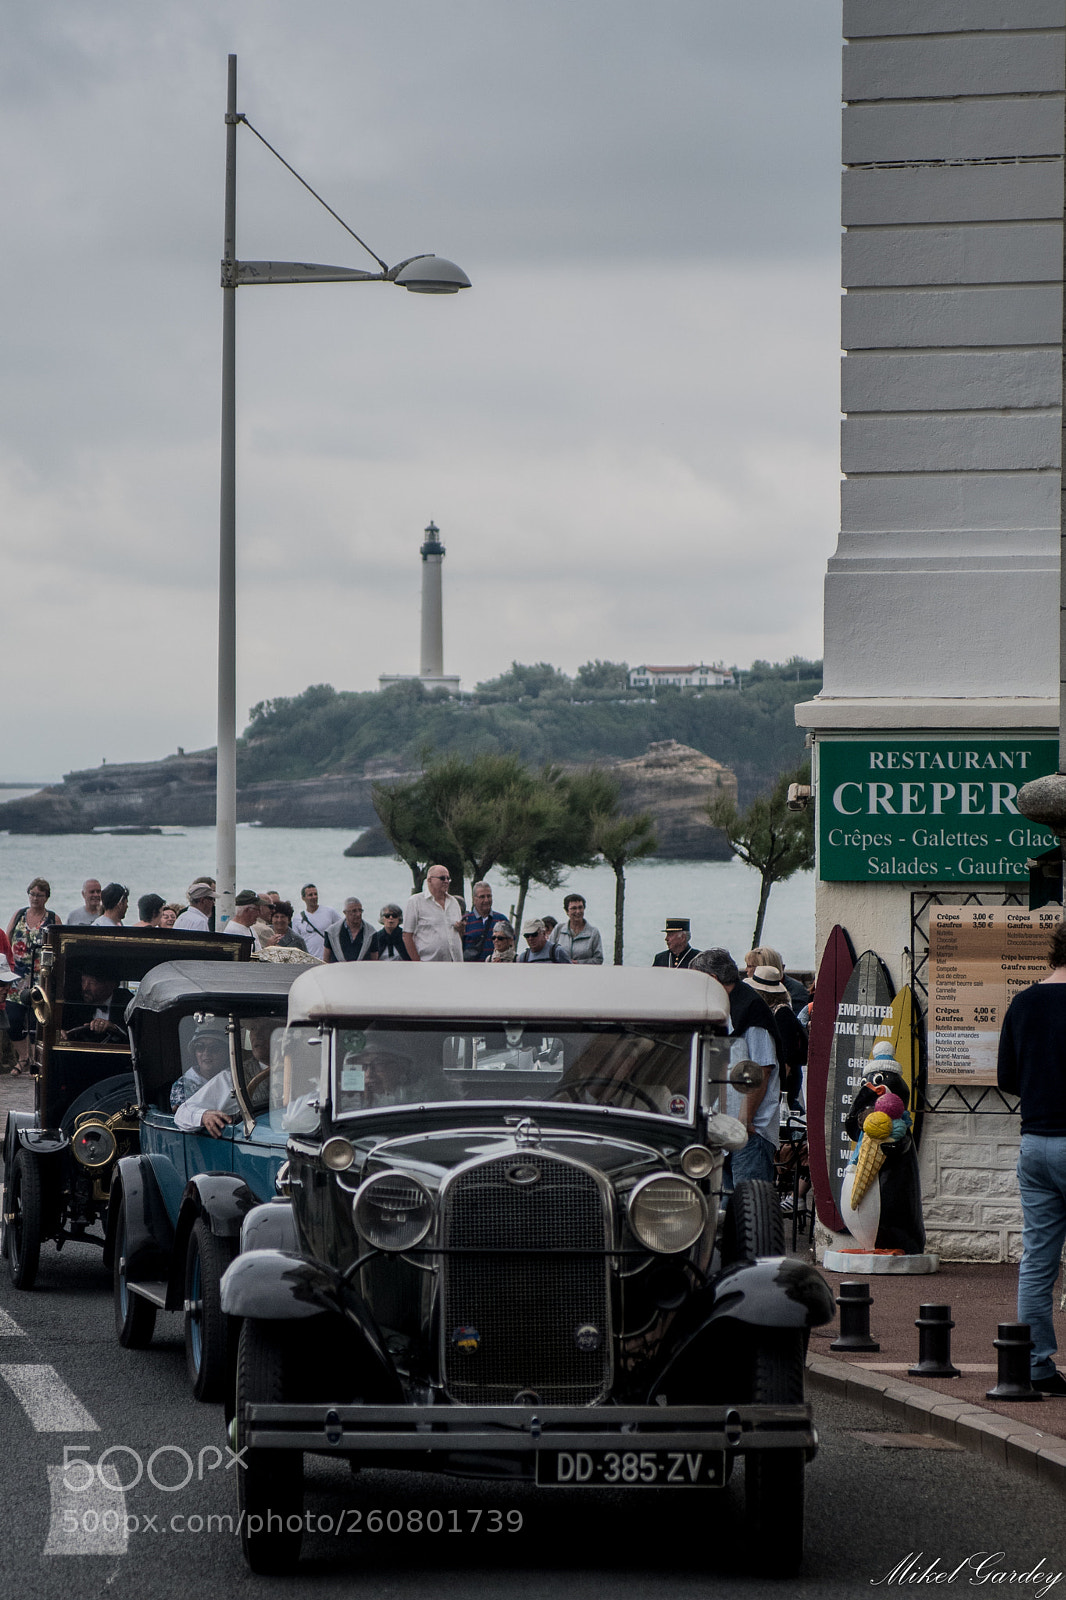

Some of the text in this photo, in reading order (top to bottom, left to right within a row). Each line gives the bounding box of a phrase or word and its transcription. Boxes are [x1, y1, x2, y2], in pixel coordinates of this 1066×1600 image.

[869, 751, 1031, 770] RESTAURANT
[832, 782, 1027, 815] CREPER
[828, 829, 892, 850] Crêpes
[912, 829, 988, 847] Galettes
[1008, 829, 1060, 847] Glace
[868, 857, 938, 875] Salades
[936, 913, 960, 921] Crêpes
[1007, 914, 1031, 922] Crêpes
[1039, 914, 1053, 922] 5,00
[1039, 922, 1053, 930] 5,50
[1007, 978, 1031, 986] Crêpes
[838, 1003, 893, 1019] EMPORTER
[935, 1007, 960, 1015] Crêpes
[974, 1007, 989, 1015] 4,00
[974, 1015, 989, 1023] 4,50
[834, 1021, 894, 1038] TAKE AWAY
[846, 1076, 862, 1087] GLA
